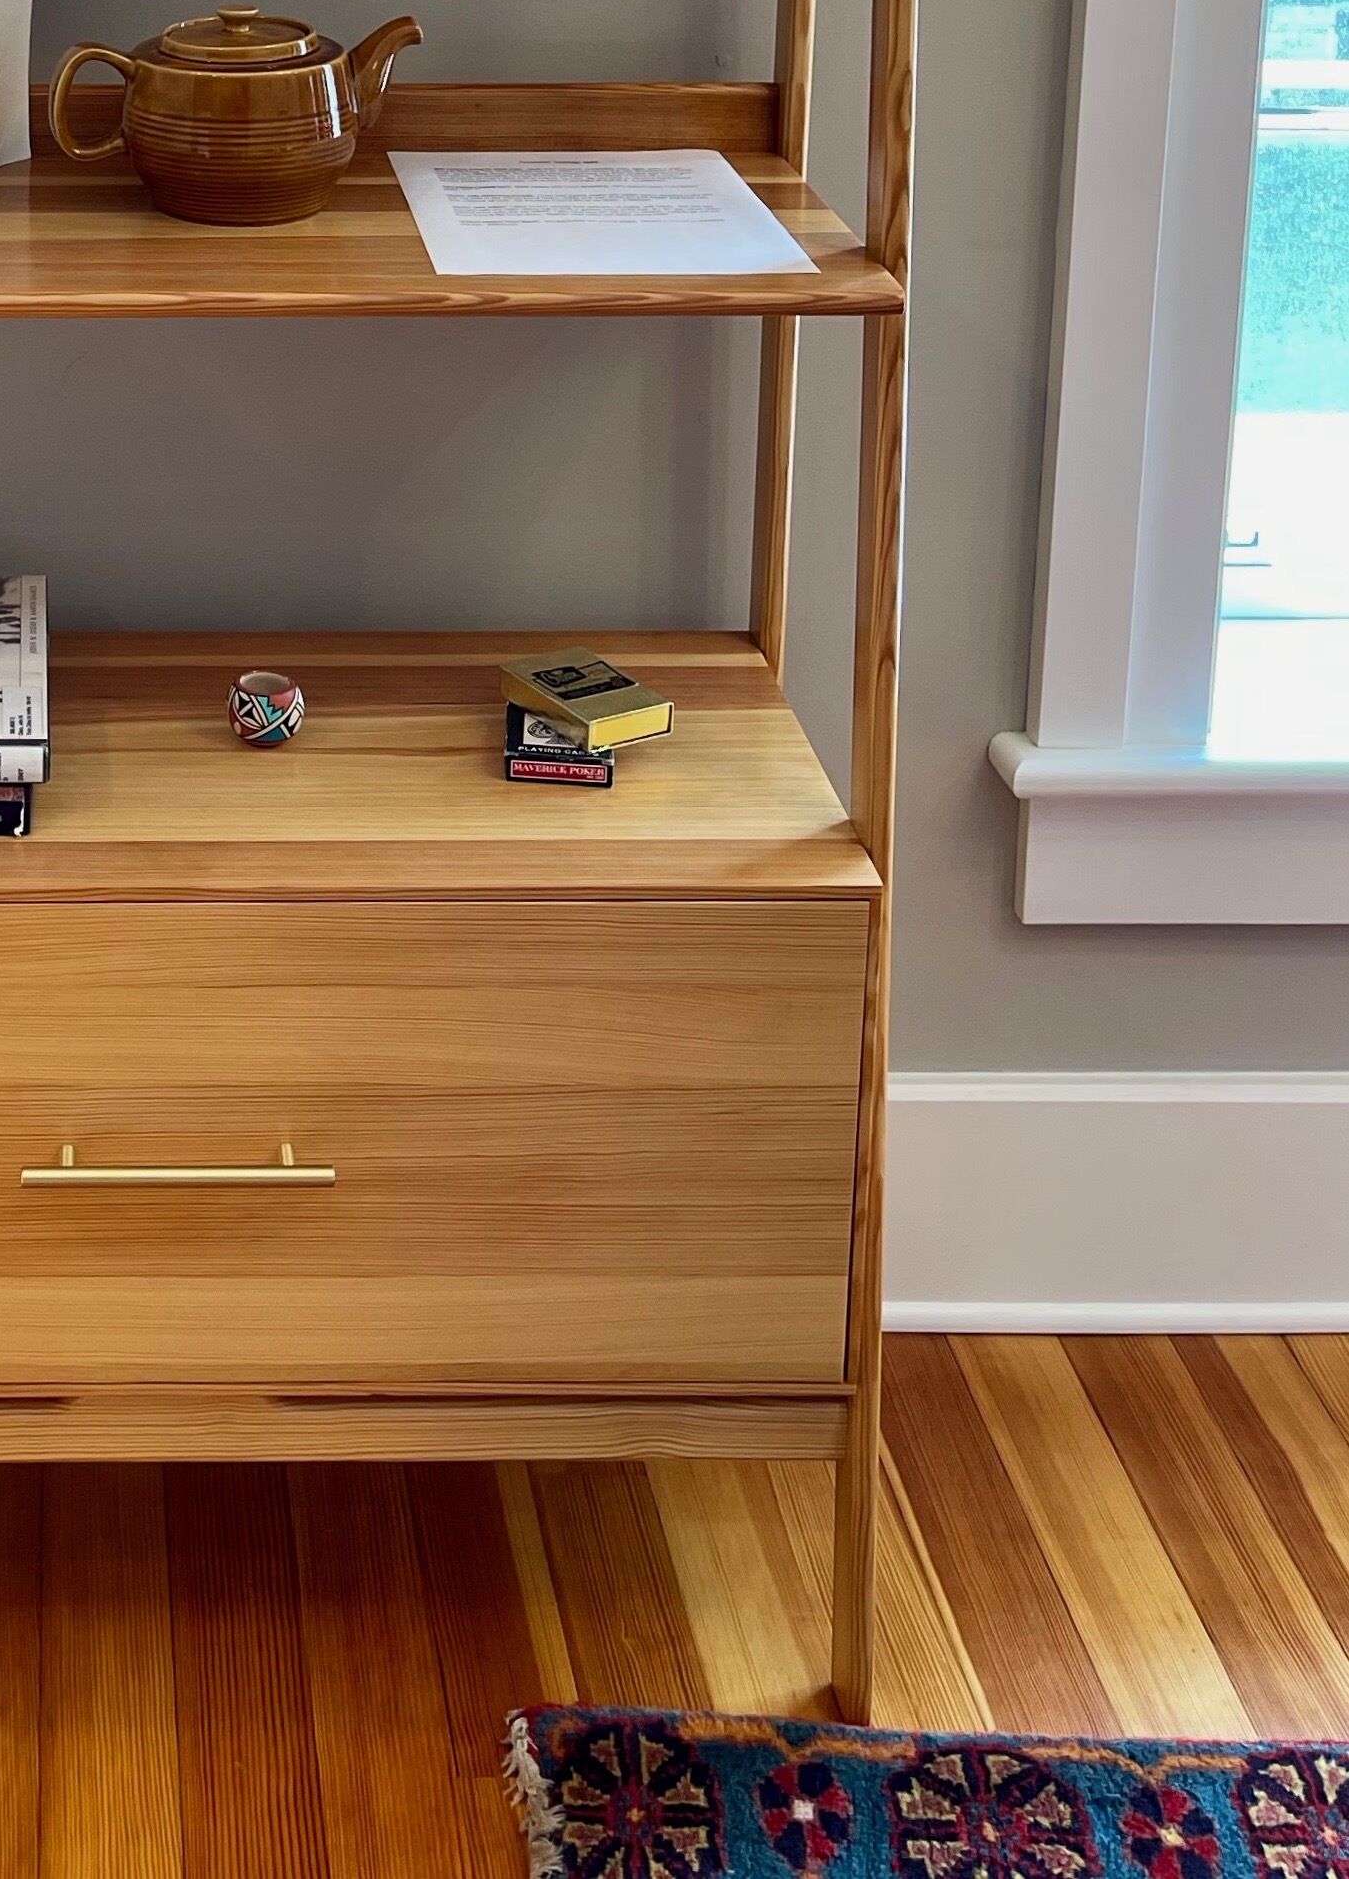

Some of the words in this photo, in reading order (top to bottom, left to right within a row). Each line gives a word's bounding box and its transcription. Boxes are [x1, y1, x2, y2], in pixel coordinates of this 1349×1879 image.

[517, 745, 561, 754] PLAYING
[513, 763, 567, 774] MAVERICK
[569, 767, 604, 776] POKER
